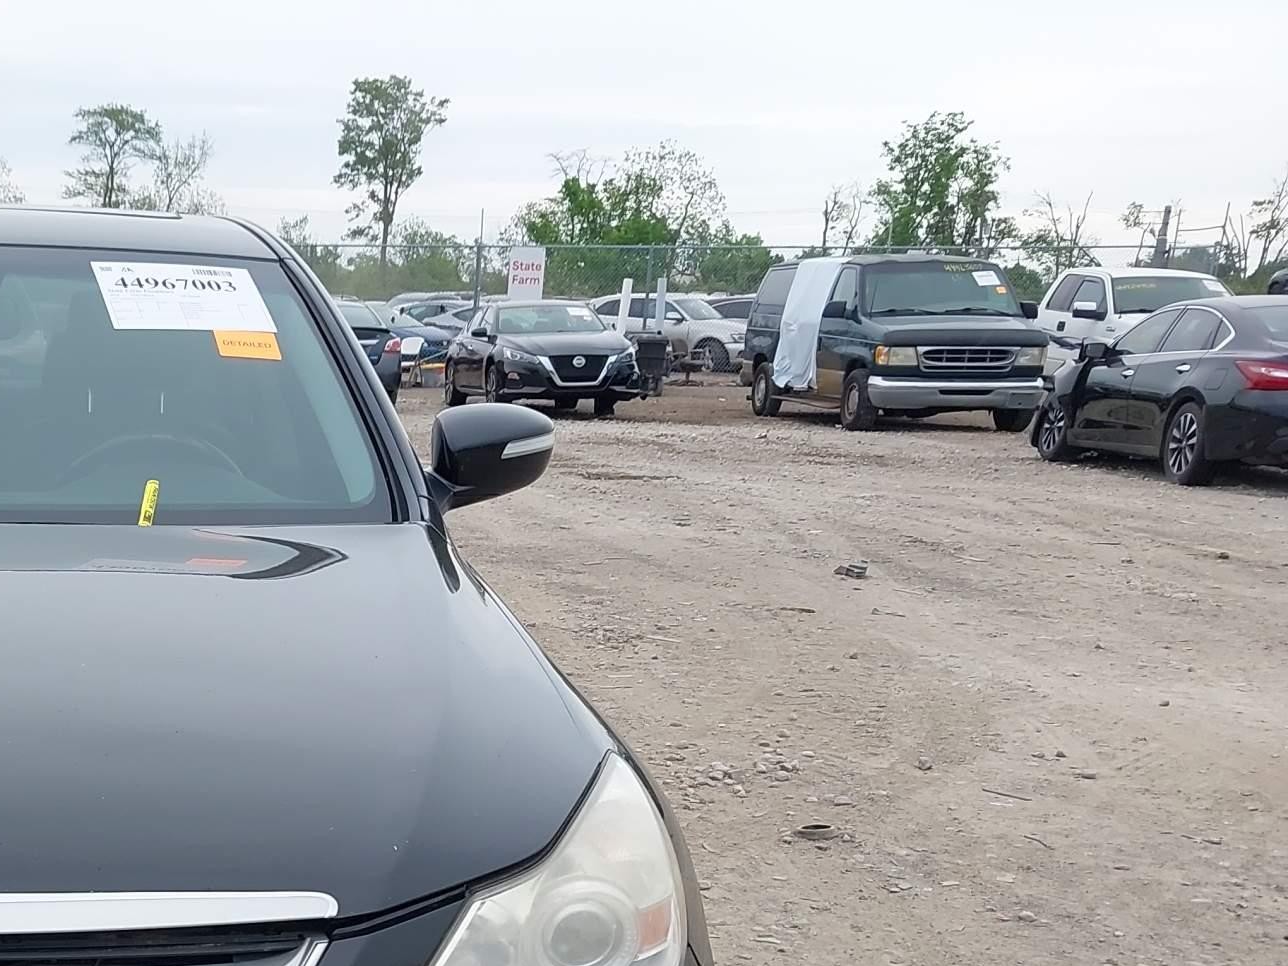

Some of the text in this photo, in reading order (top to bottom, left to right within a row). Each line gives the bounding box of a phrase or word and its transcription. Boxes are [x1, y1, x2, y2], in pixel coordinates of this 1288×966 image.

[512, 260, 542, 272] State
[114, 276, 237, 293] 44967003
[512, 274, 540, 286] Farm
[222, 338, 272, 349] DETAILED
